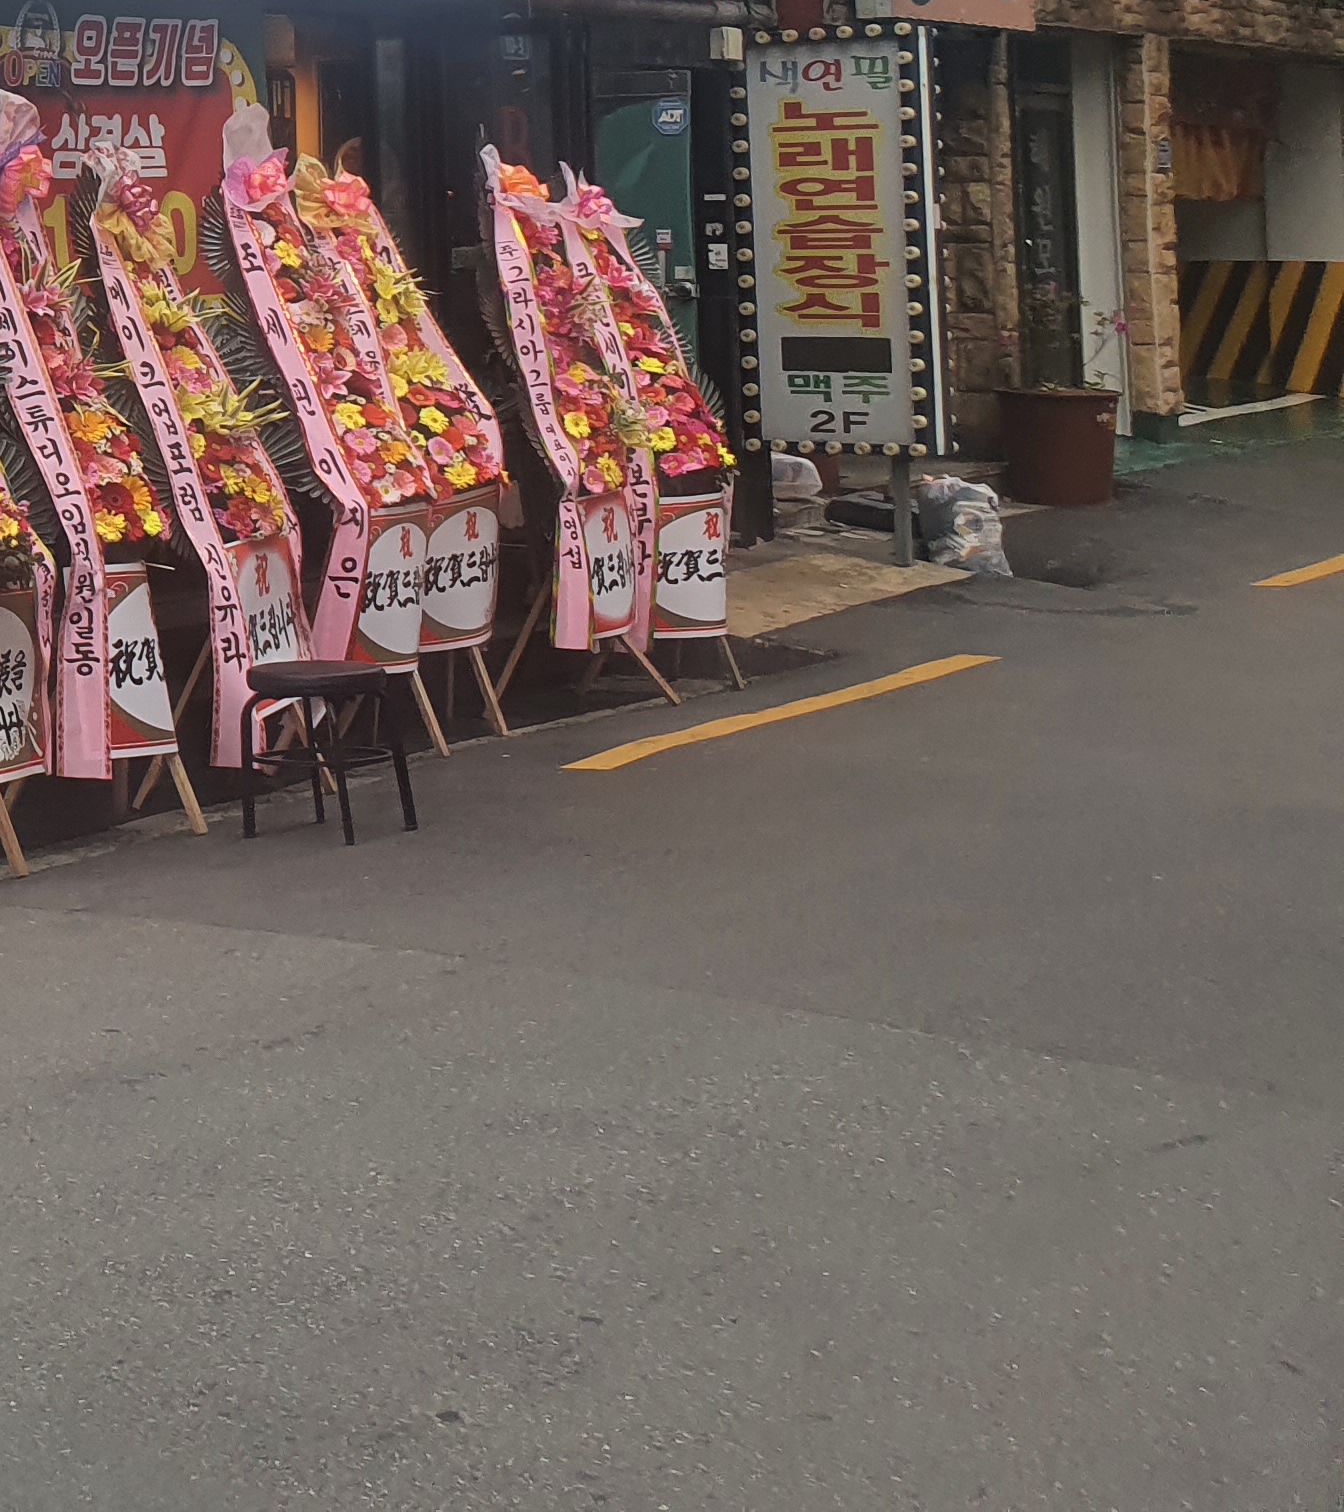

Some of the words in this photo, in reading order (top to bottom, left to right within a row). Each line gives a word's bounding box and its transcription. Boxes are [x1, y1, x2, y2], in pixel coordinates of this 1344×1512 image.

[4, 49, 61, 87] OPEN
[71, 14, 219, 88] 오픈기념
[658, 109, 684, 123] ADT
[787, 374, 891, 404] 맥주
[810, 410, 870, 434] 2F
[204, 543, 247, 674] 신유라
